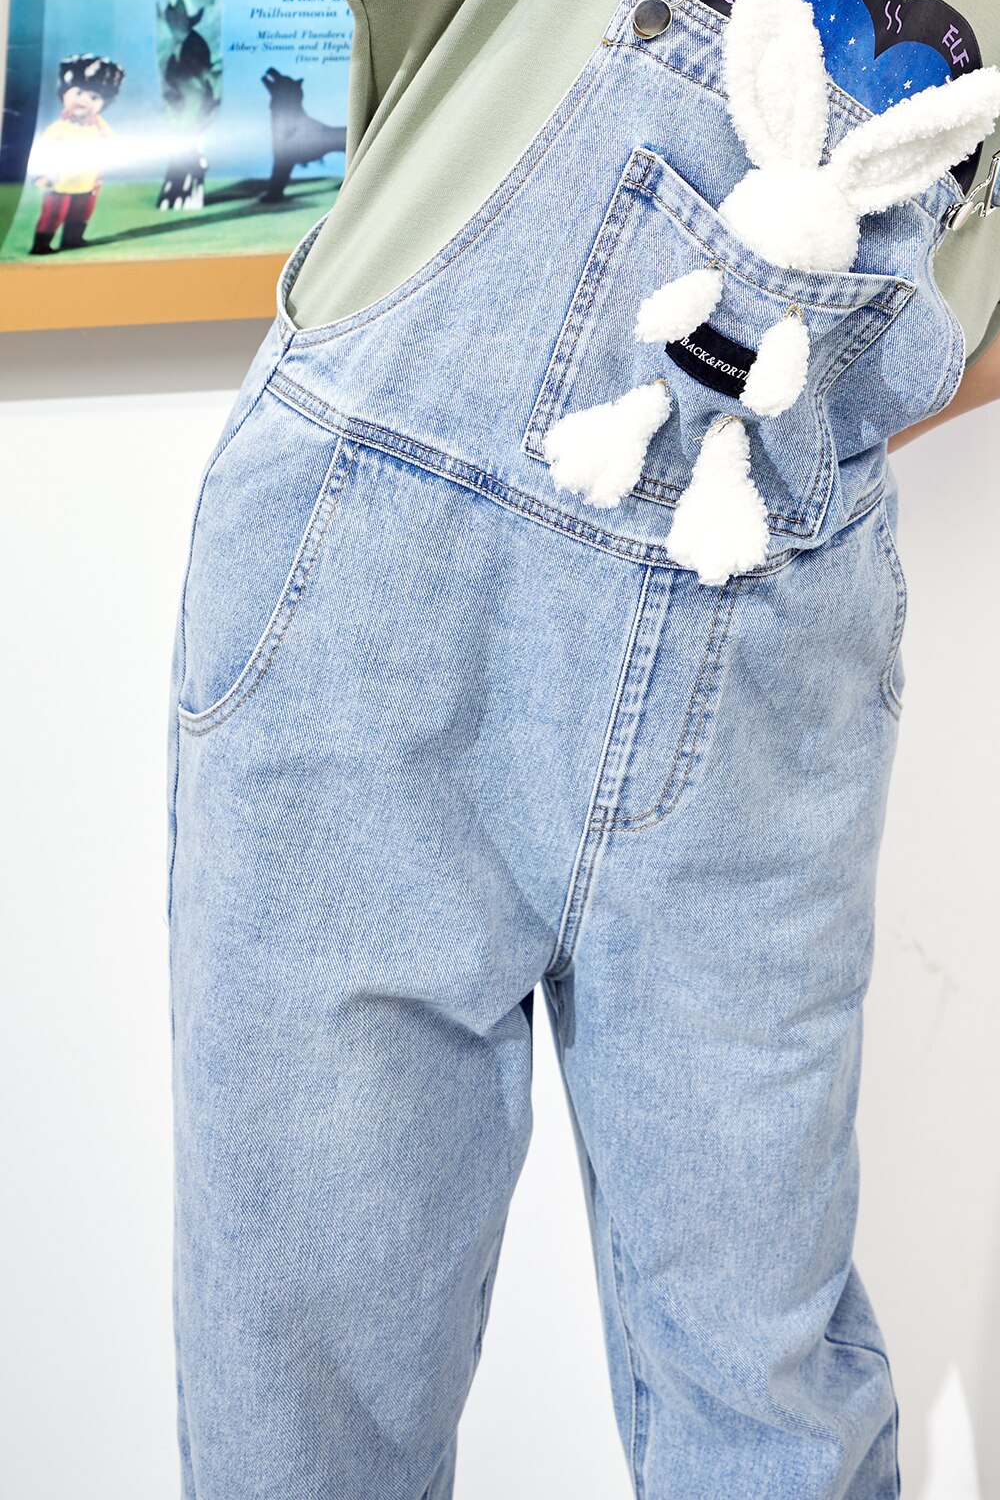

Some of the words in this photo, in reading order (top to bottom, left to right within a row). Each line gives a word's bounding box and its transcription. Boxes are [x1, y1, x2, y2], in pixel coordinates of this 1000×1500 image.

[250, 7, 337, 19] Philharmonia
[257, 30, 298, 40] Michael
[298, 41, 318, 51] and
[941, 23, 970, 68] ELF
[679, 336, 750, 381] BACK&FORT
